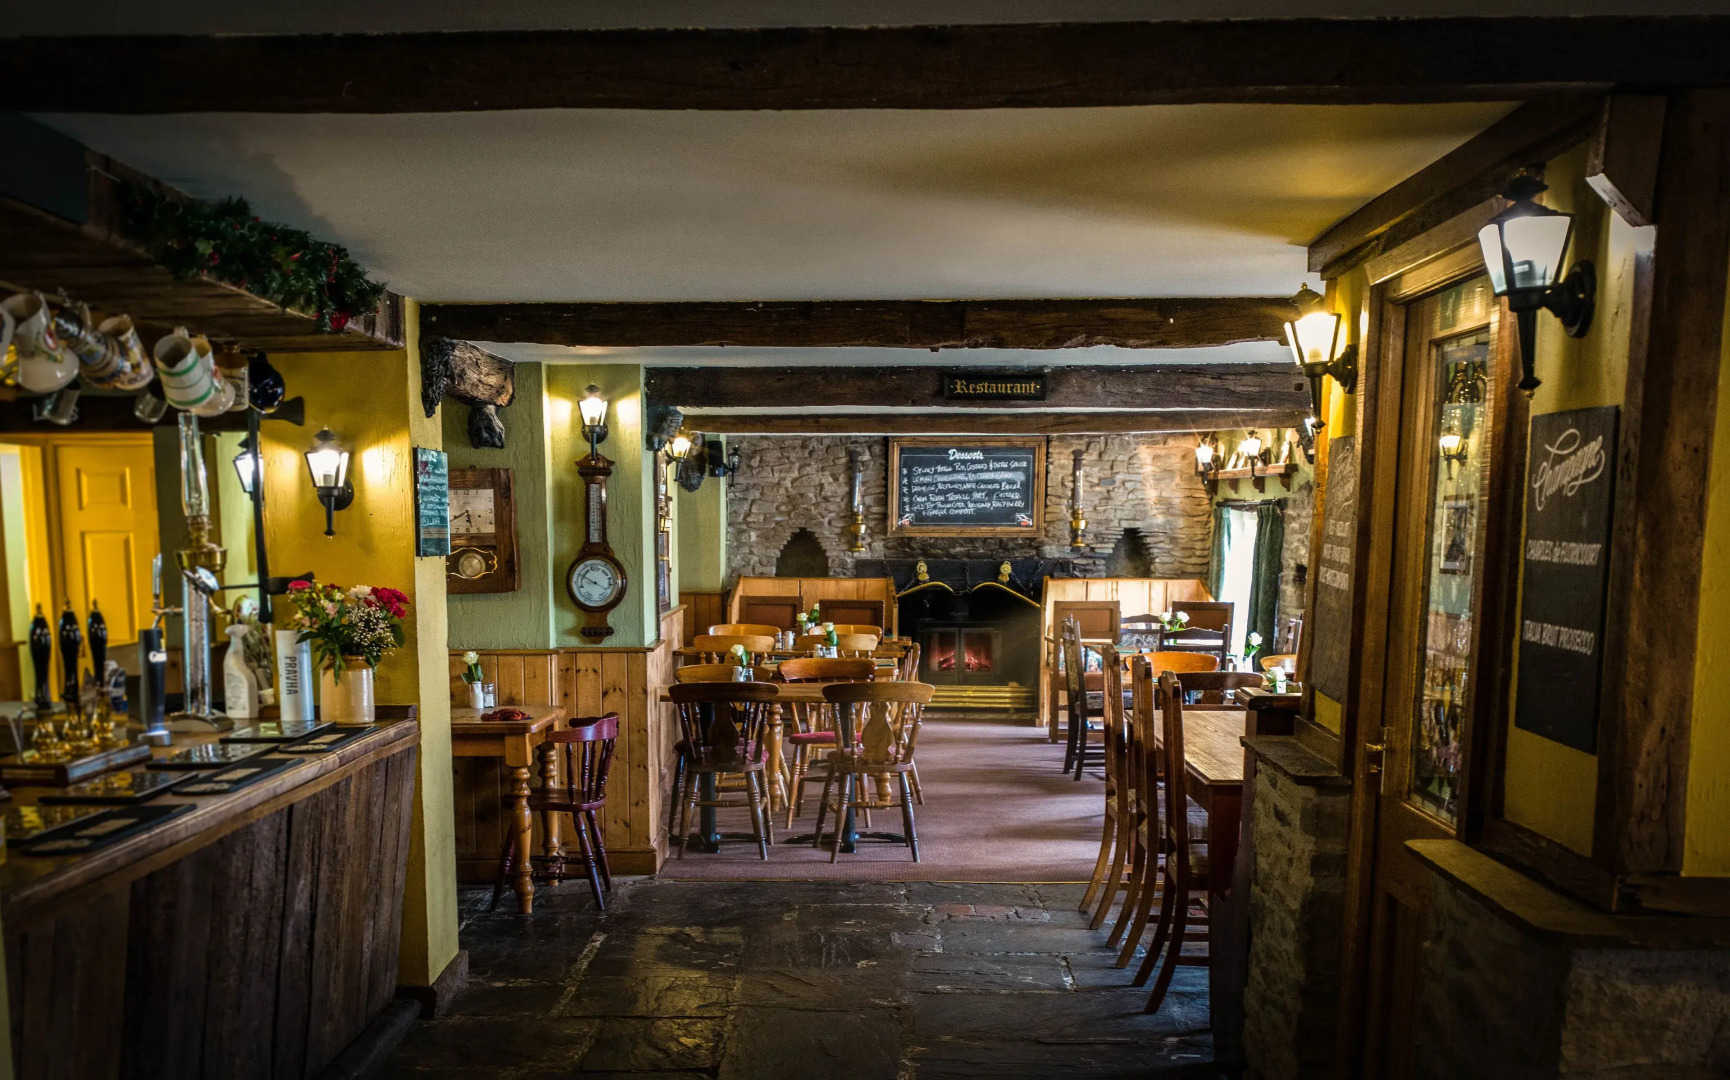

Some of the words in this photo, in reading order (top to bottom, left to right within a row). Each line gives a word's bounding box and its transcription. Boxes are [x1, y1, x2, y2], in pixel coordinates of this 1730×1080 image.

[953, 379, 1035, 394] Restaurant
[948, 448, 984, 460] Desserts
[1532, 428, 1605, 511] Champagne
[284, 655, 298, 695] PRAVHA
